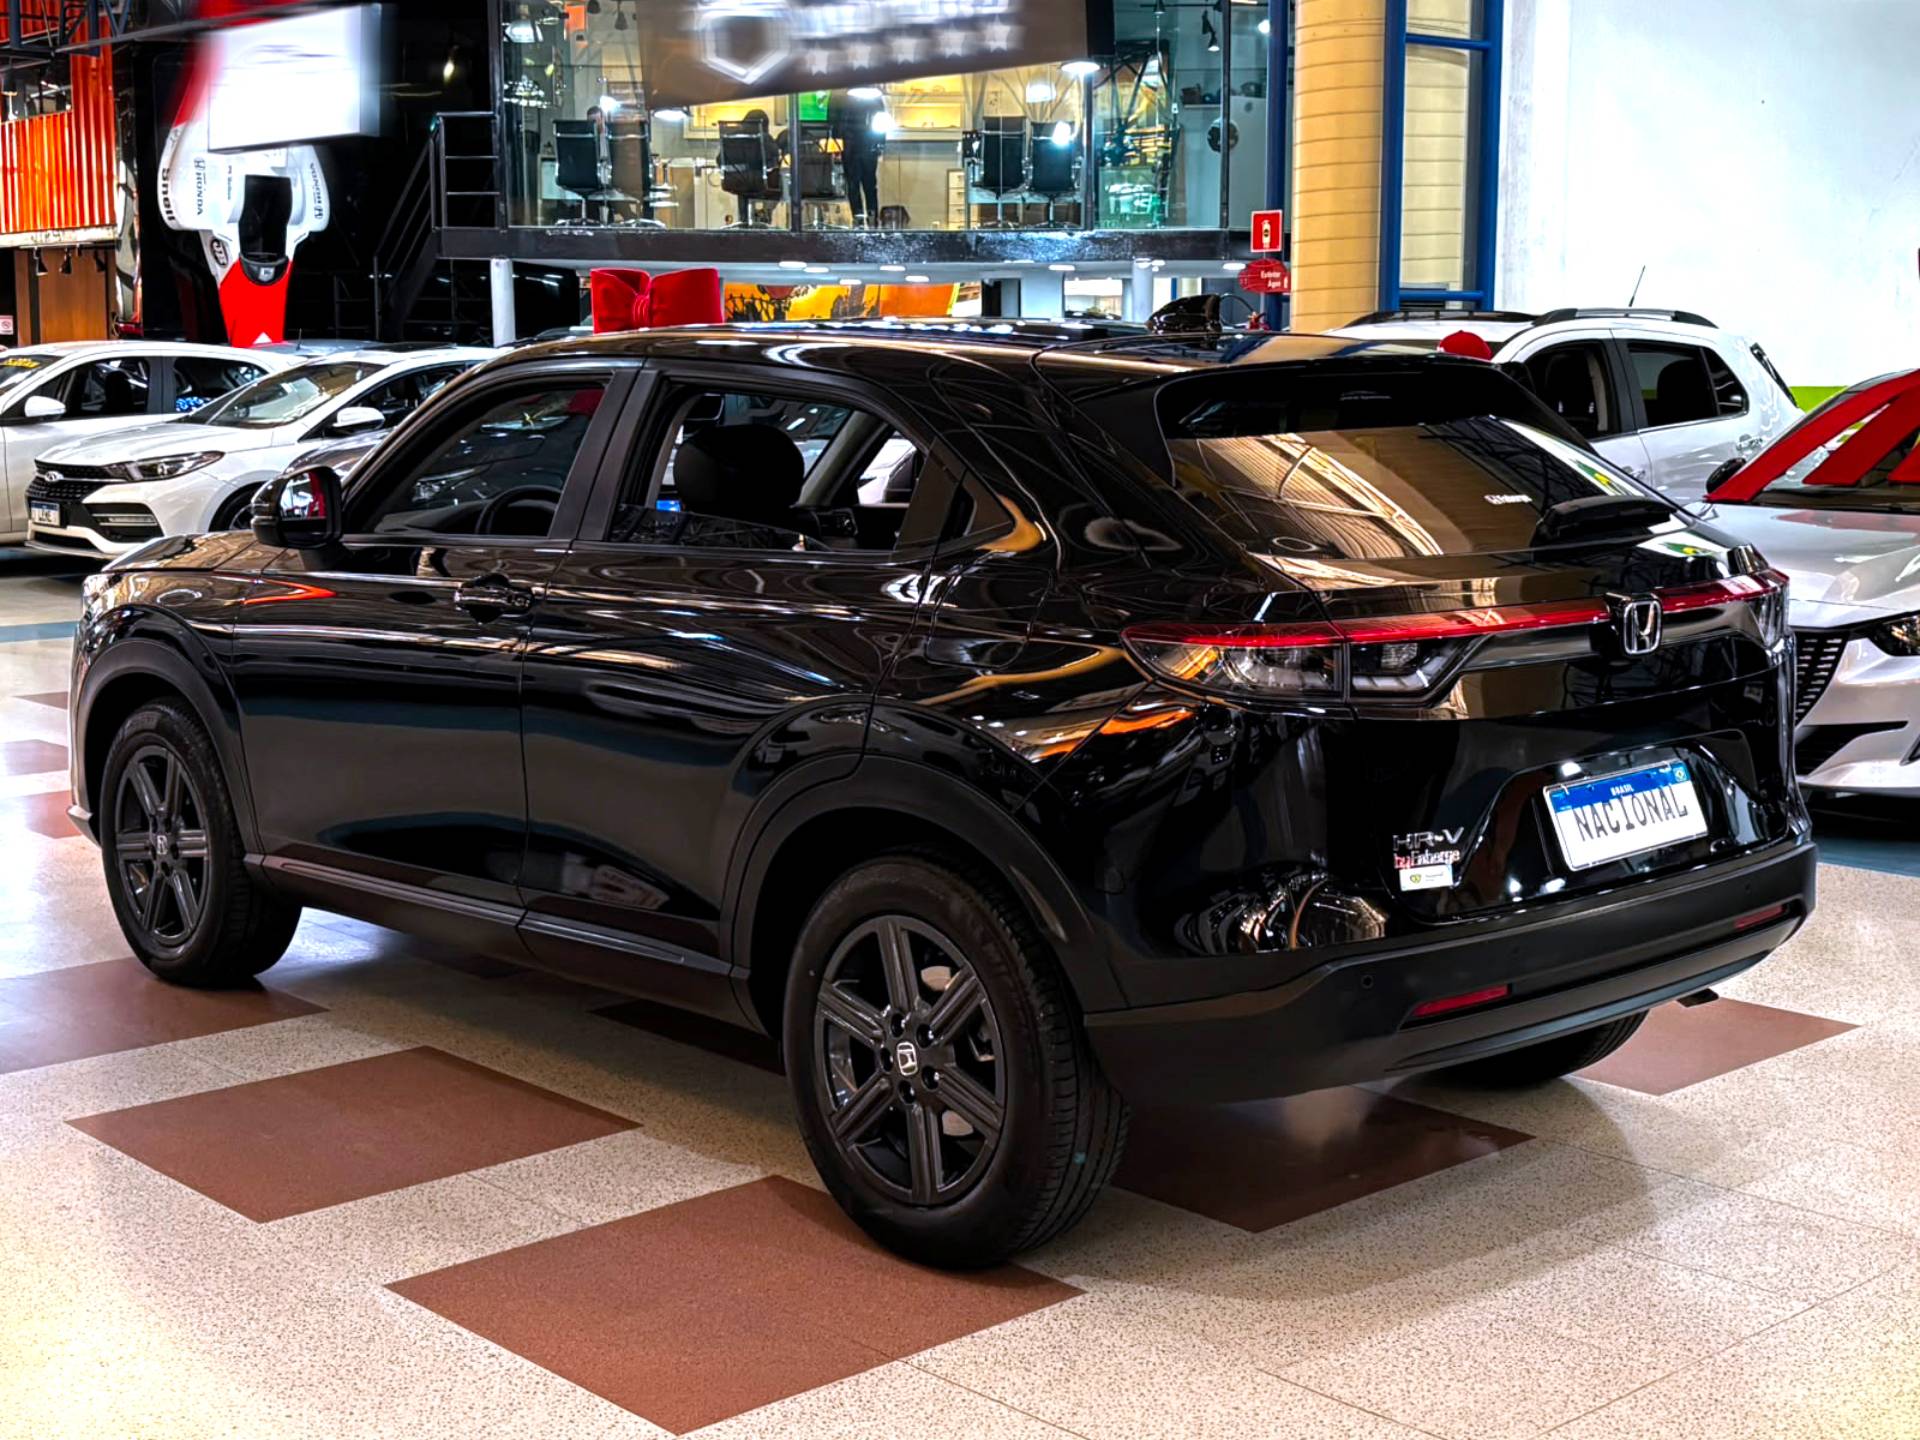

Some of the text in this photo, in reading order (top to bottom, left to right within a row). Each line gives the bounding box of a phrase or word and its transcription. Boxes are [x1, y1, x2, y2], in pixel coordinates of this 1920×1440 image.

[196, 172, 204, 216] HONDA
[1610, 784, 1635, 797] BRASIL
[1573, 784, 1688, 842] NACIONAL
[1392, 827, 1464, 851] HR-V
